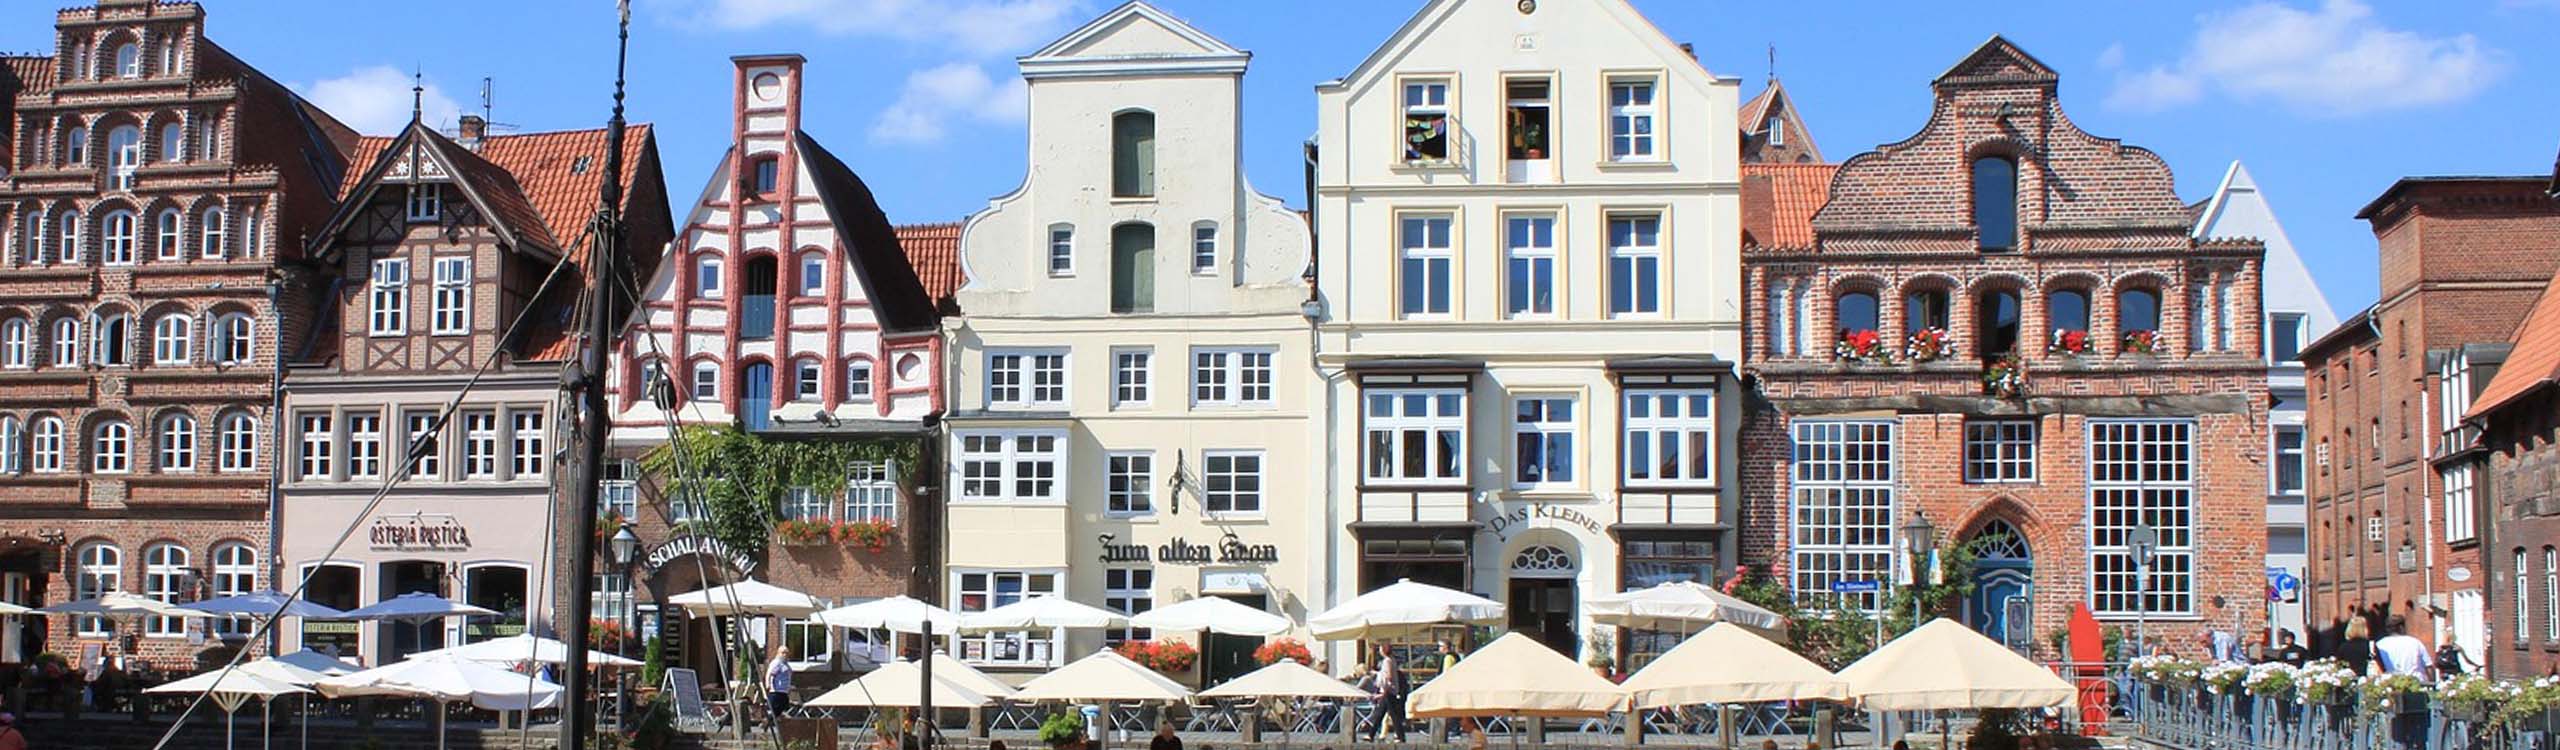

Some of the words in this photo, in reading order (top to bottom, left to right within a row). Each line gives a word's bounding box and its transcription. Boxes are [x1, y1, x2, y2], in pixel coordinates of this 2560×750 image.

[1491, 507, 1529, 532] DAS
[1534, 502, 1601, 535] KLEINE
[370, 526, 417, 544] OSTERIA
[419, 526, 469, 545] RUSTICA
[1098, 534, 1150, 563] Zum
[1158, 536, 1212, 563] alten
